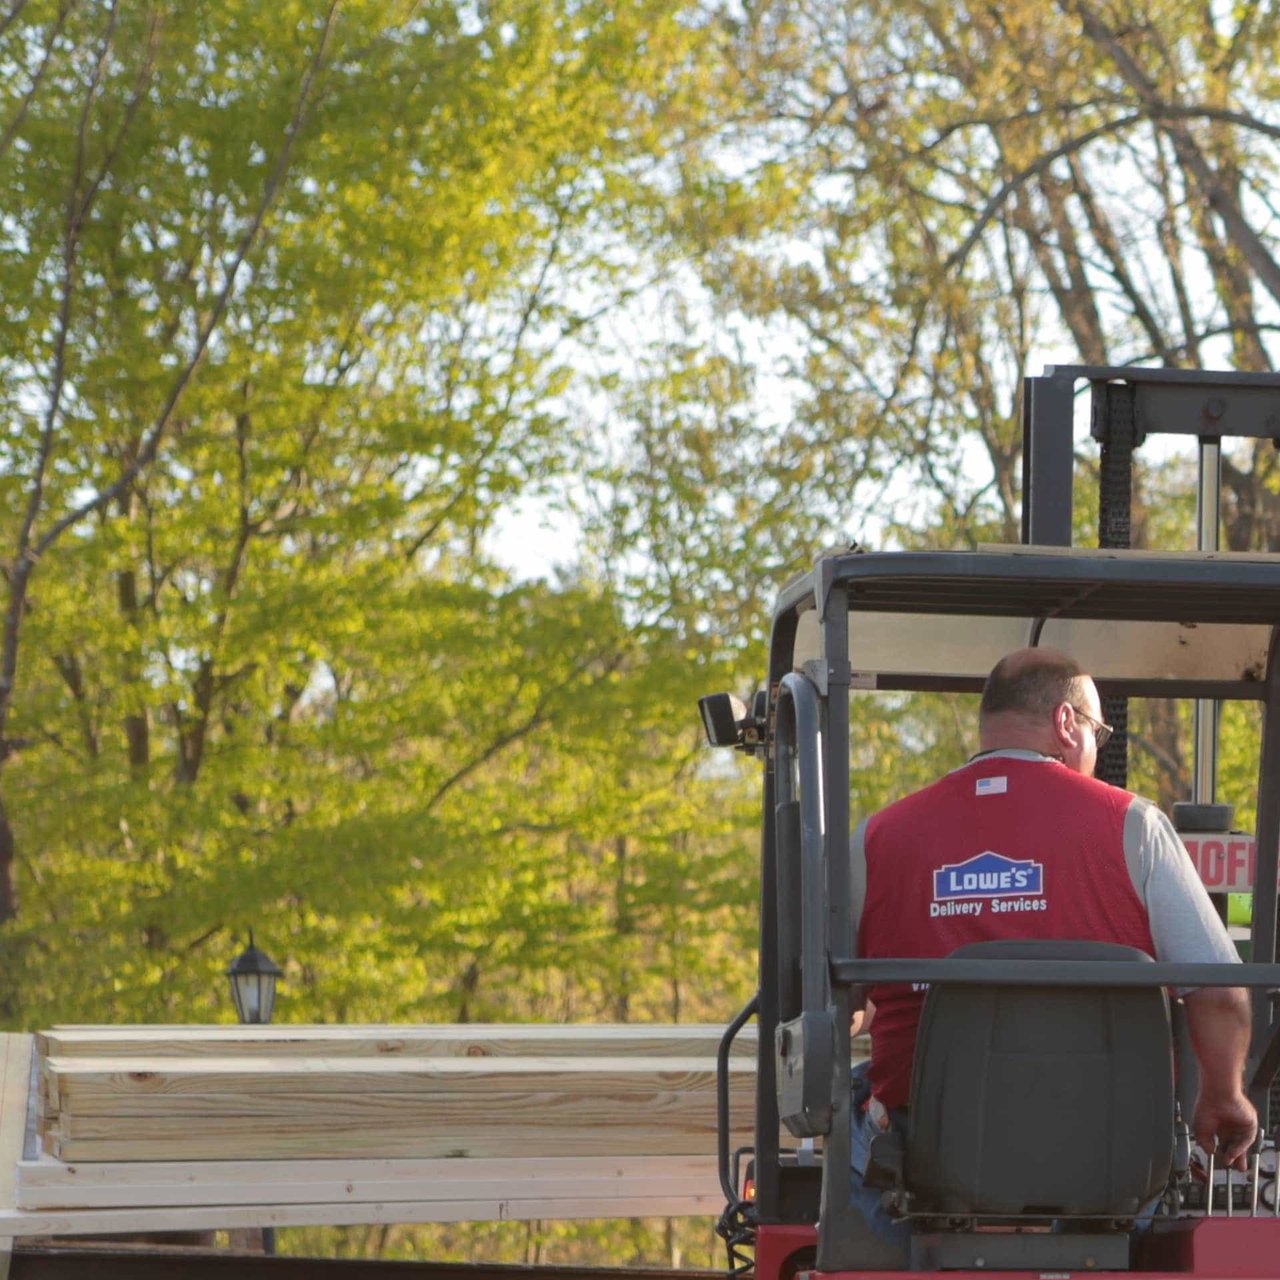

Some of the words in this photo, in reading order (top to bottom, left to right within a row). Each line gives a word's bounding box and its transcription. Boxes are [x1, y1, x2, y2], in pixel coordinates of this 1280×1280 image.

[950, 867, 1028, 892] LOWE'S
[930, 900, 983, 918] Delivery
[991, 898, 1047, 914] Services
